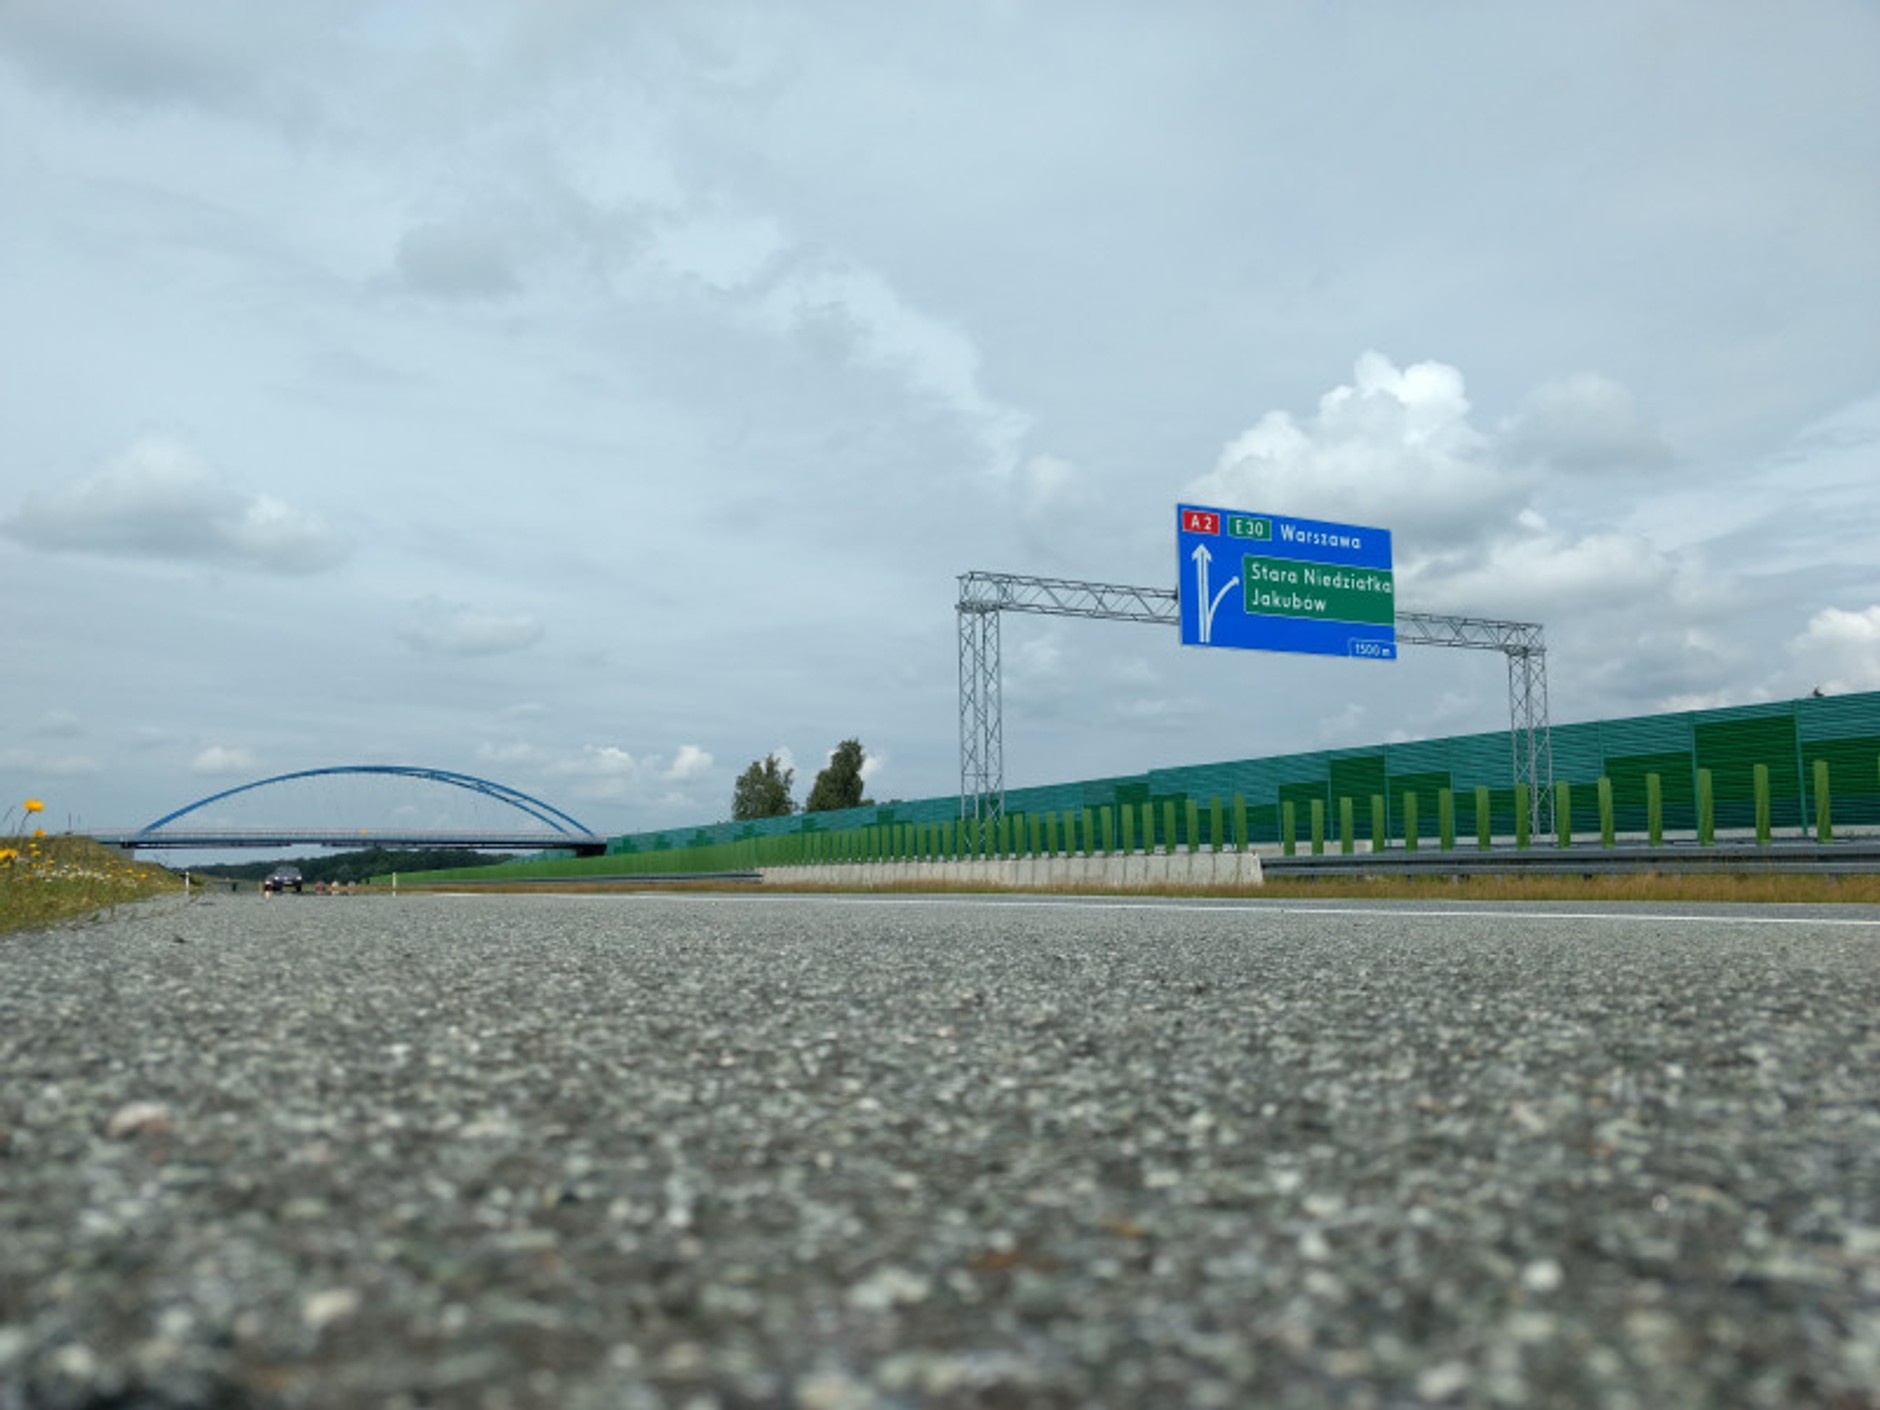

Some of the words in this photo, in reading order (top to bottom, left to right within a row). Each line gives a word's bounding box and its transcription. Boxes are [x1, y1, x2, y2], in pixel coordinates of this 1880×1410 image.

[1280, 524, 1361, 549] Warszawa
[1252, 563, 1298, 584] Stara
[1304, 567, 1392, 594] Niedziałka
[1252, 589, 1327, 612] Jakubów
[1355, 643, 1379, 657] 1500
